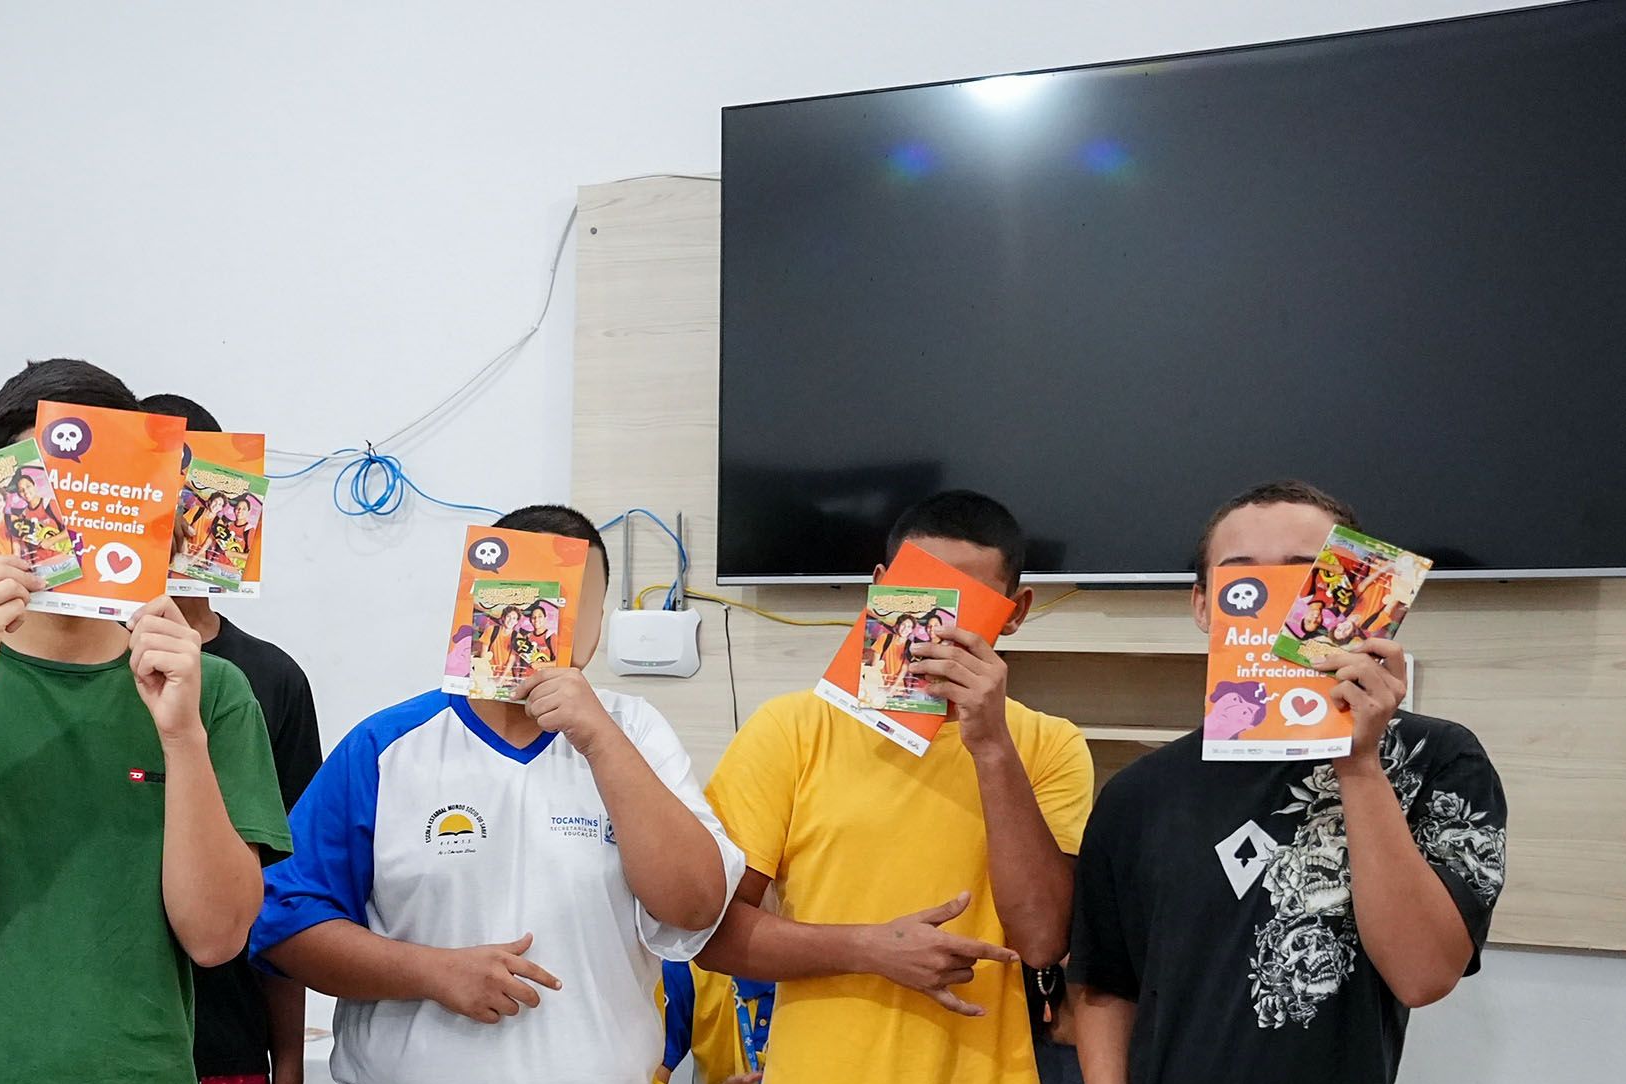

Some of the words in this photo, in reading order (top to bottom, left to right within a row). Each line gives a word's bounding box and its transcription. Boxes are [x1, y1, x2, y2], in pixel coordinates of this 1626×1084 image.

[49, 469, 164, 502] Adolescente
[65, 499, 74, 509] e
[81, 500, 99, 512] os
[106, 500, 140, 517] atos
[62, 510, 145, 535] nfracionais
[1245, 652, 1255, 662] e
[551, 816, 599, 827] TOCANTINS
